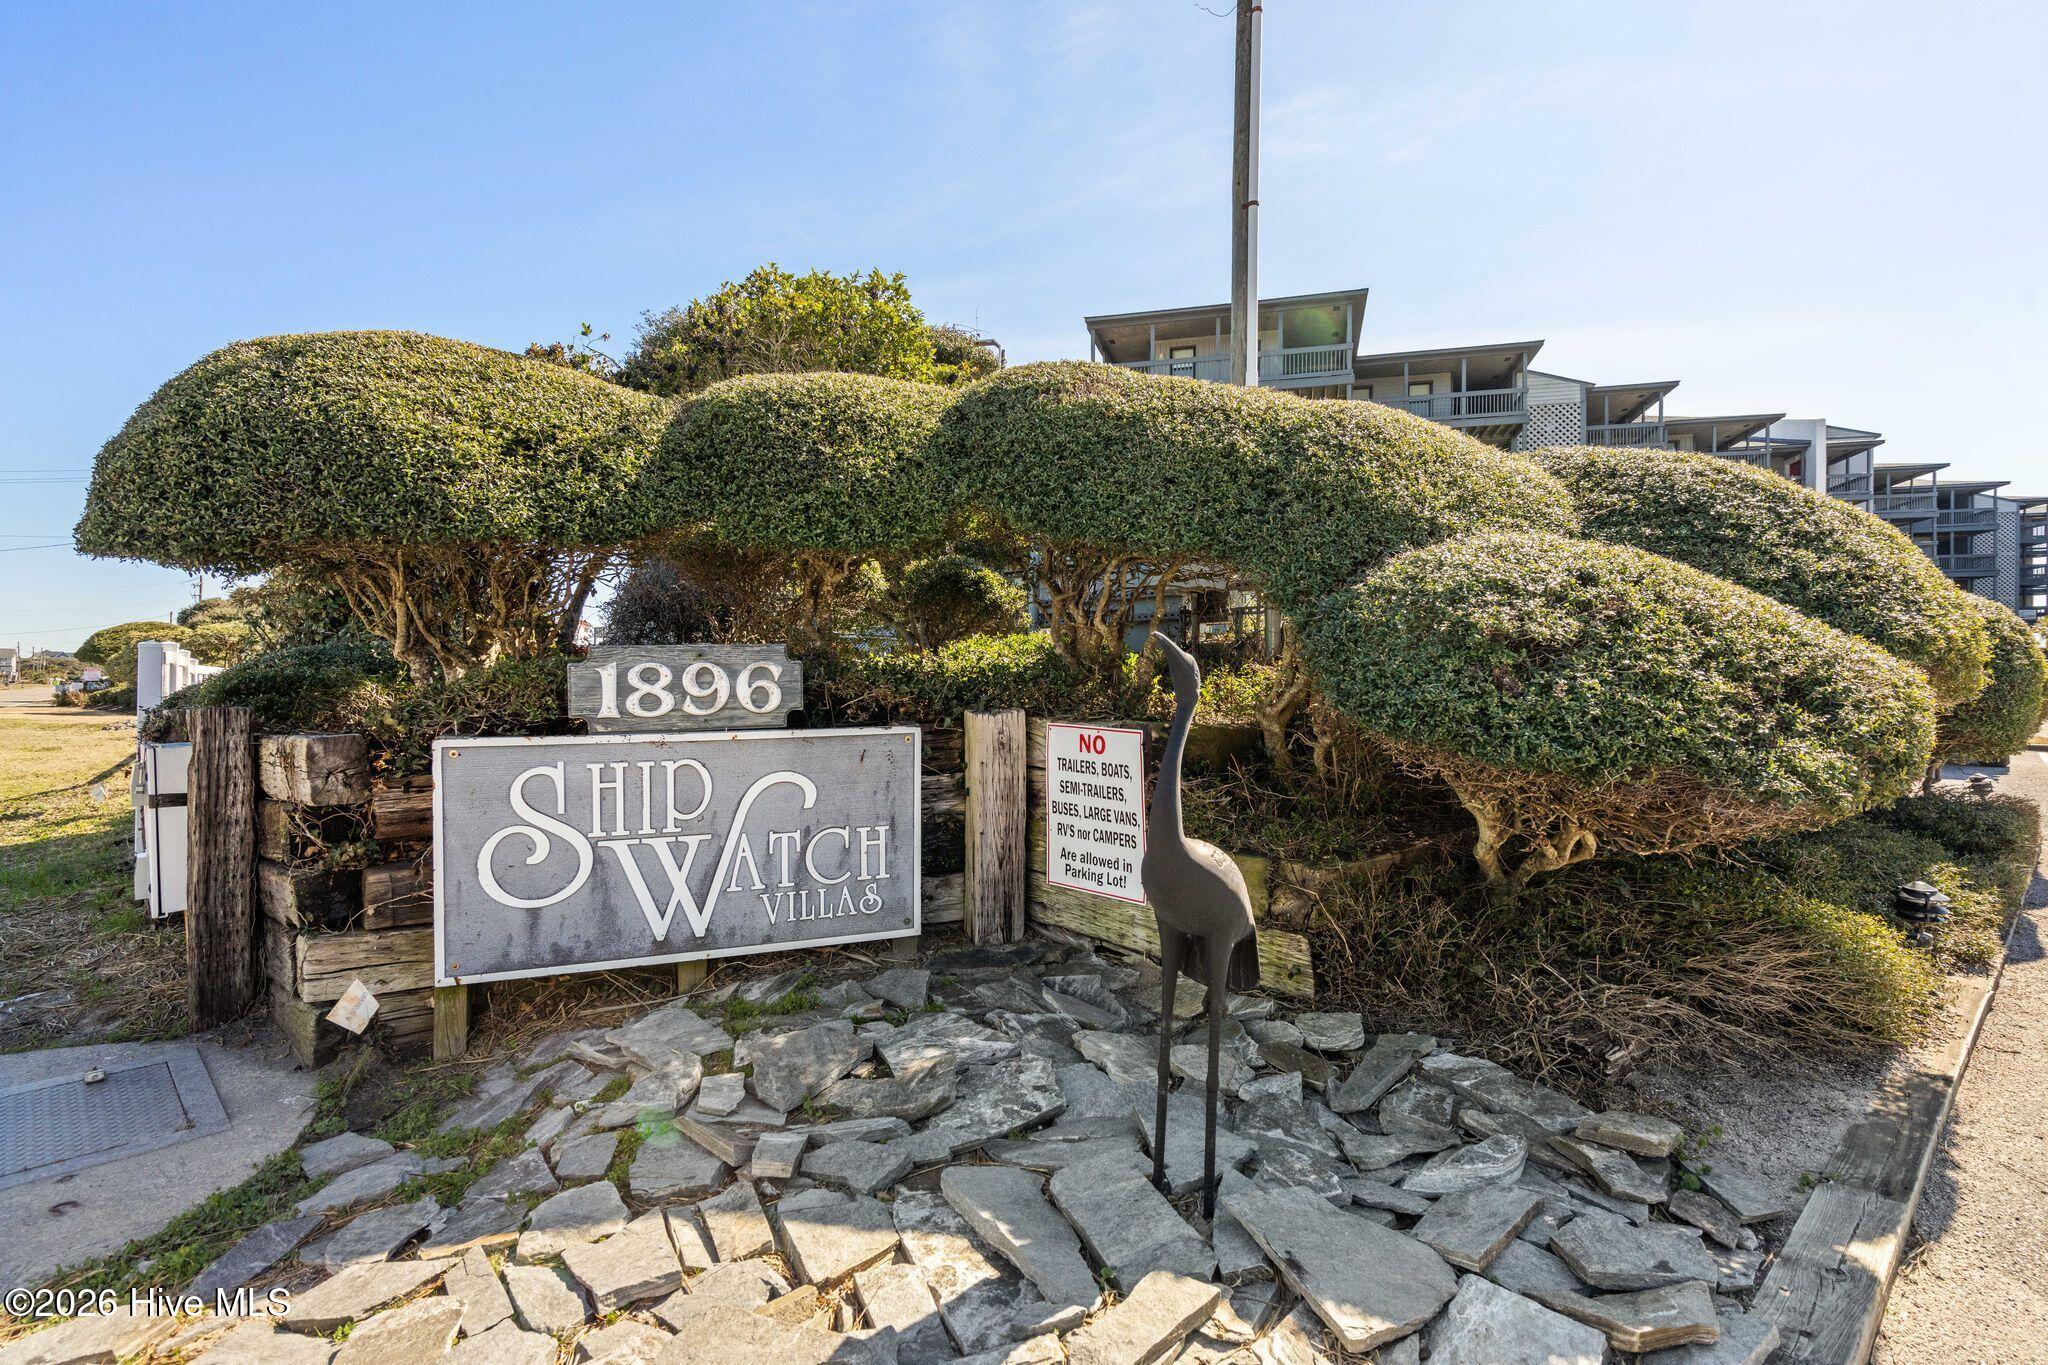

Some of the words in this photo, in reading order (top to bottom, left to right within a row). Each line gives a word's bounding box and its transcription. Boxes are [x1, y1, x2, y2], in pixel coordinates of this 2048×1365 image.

[595, 661, 783, 719] 1896
[1079, 733, 1106, 755] NO
[1057, 757, 1099, 778] TRAILERS,
[1101, 762, 1133, 782] BOATS,
[1059, 780, 1127, 805] SEMI-TRAILERS,
[1052, 801, 1082, 820] BUSES,
[1083, 805, 1112, 824] LARGE
[1114, 810, 1141, 831] VANS,
[477, 758, 713, 909] SHIP
[1057, 822, 1075, 838] RV'S
[1077, 828, 1091, 841] nor
[1093, 828, 1137, 849] CAMPERS
[598, 771, 890, 941] WATCH
[1060, 847, 1077, 862] Are
[1080, 851, 1120, 870] allowed
[1123, 858, 1133, 873] in
[1065, 864, 1104, 886] Parking
[1107, 871, 1127, 888] Lot!
[759, 882, 883, 925] VILLAS
